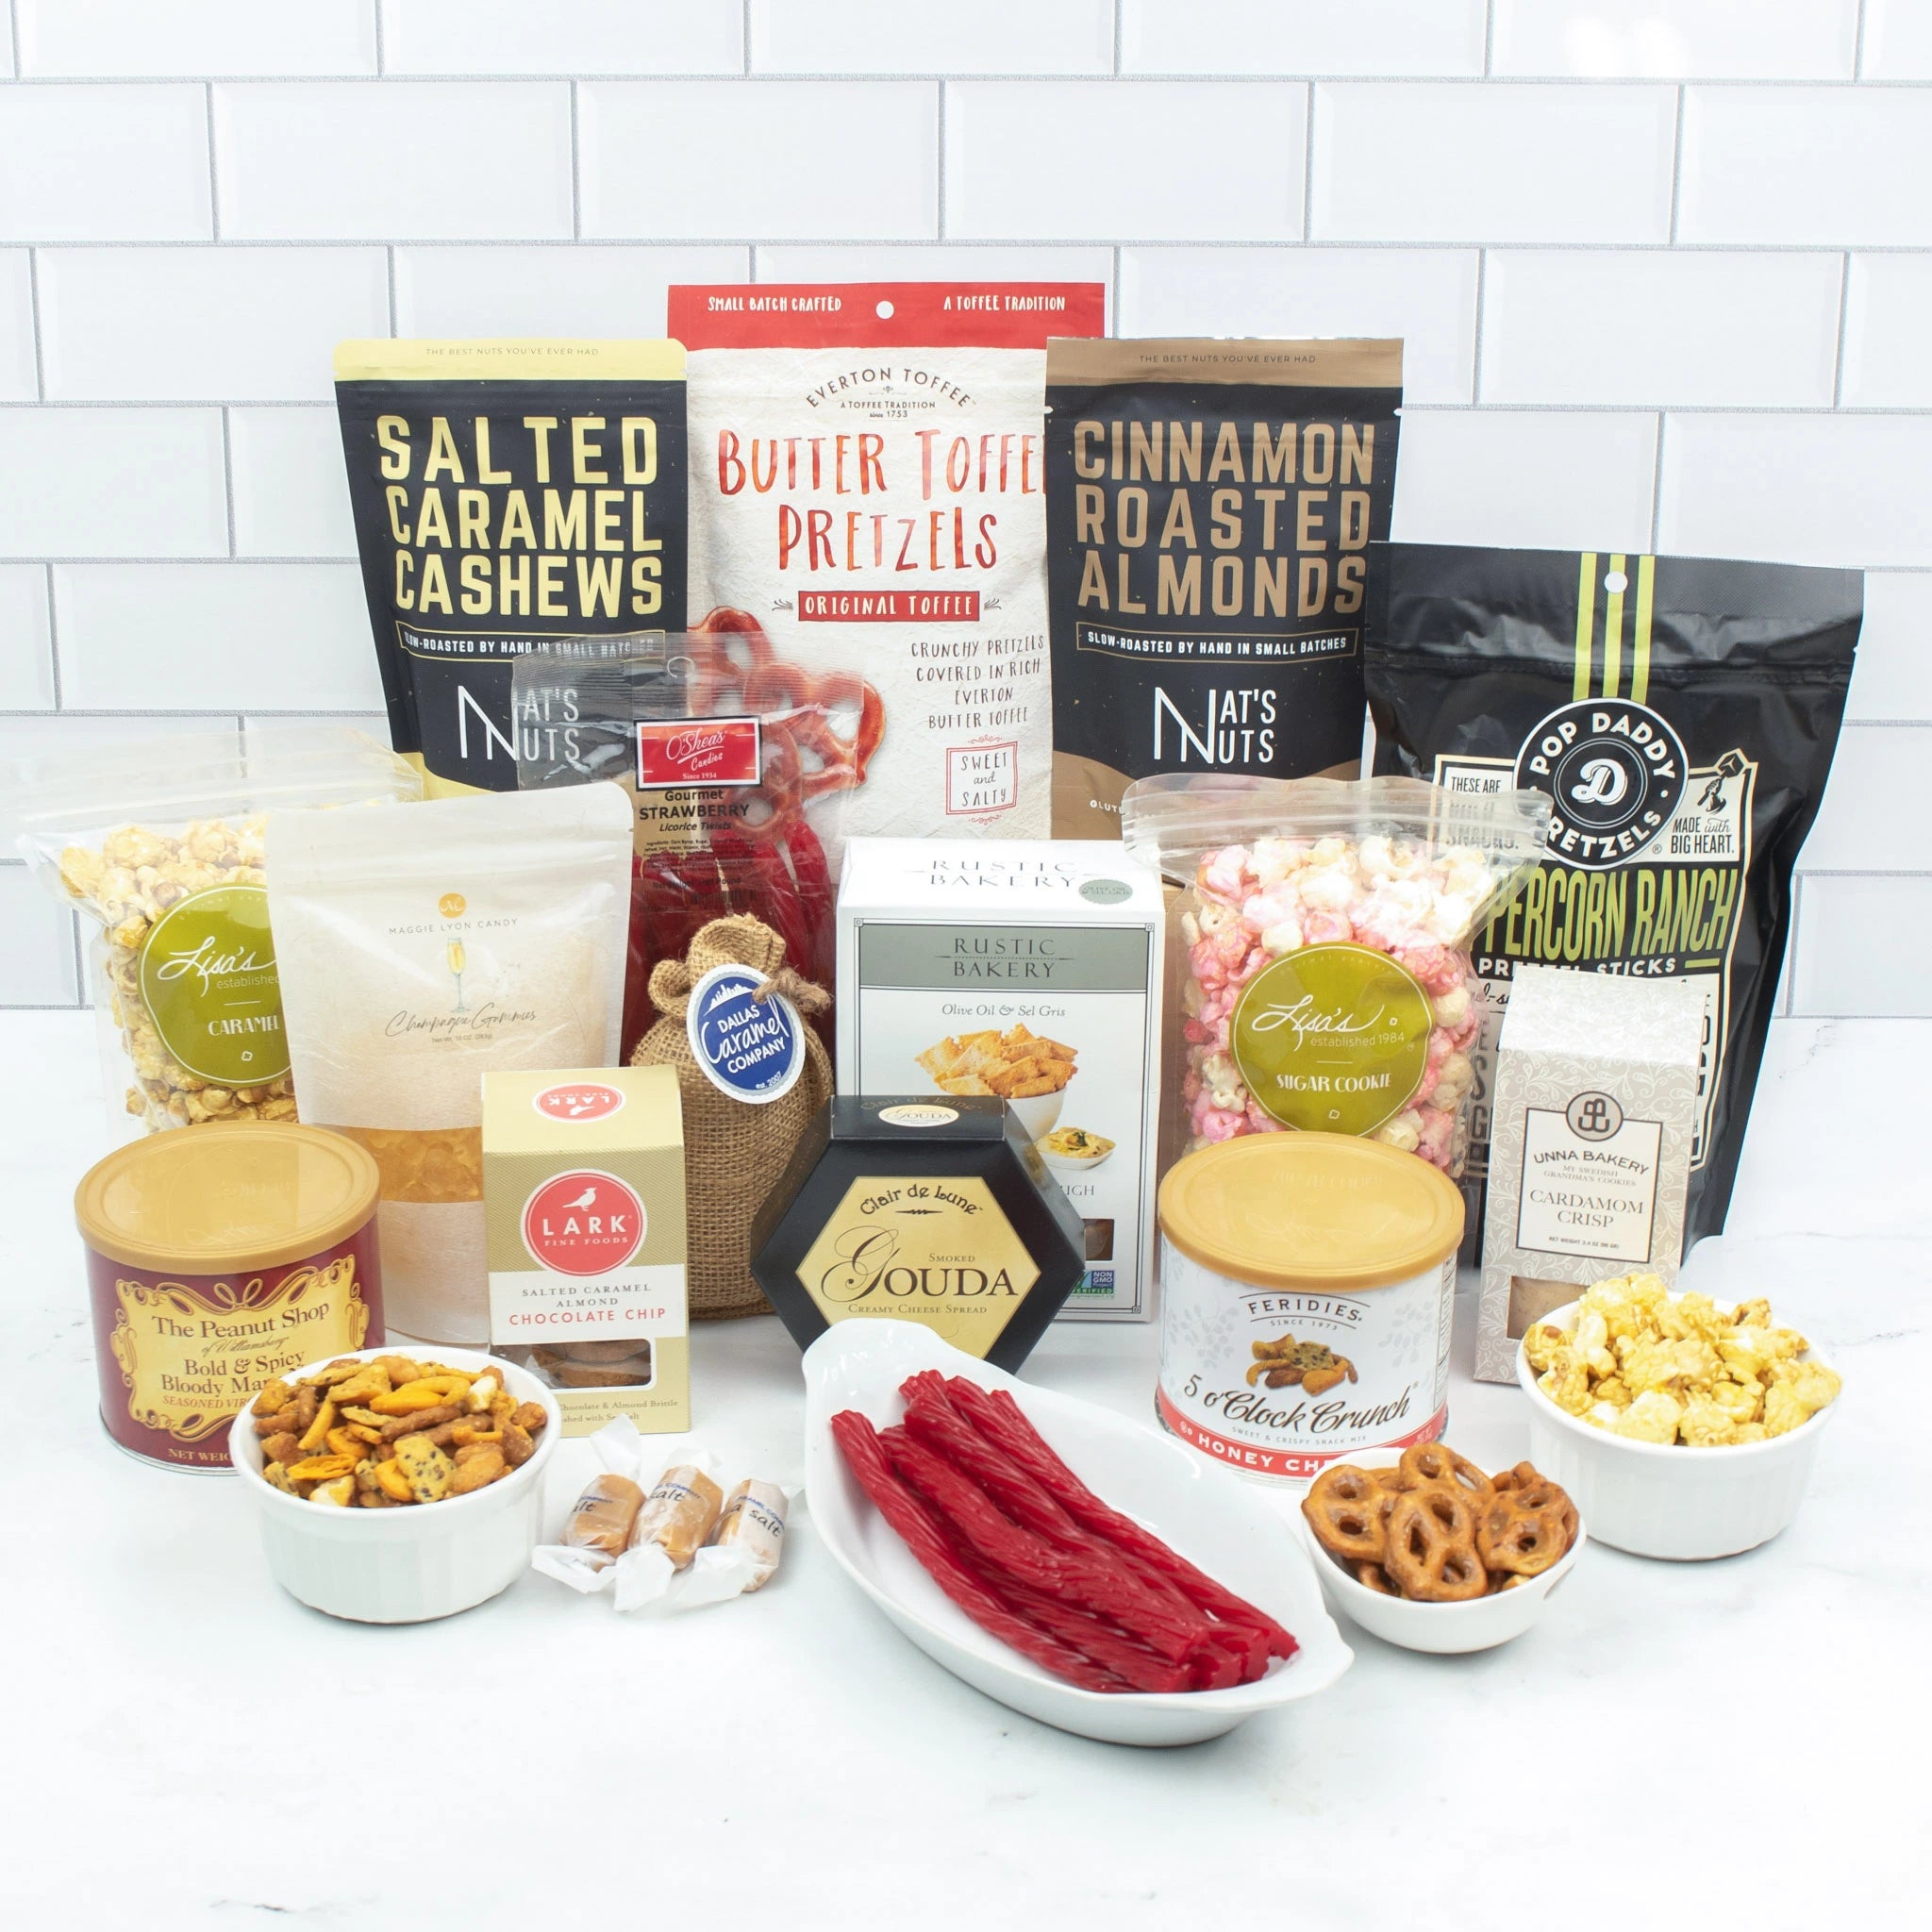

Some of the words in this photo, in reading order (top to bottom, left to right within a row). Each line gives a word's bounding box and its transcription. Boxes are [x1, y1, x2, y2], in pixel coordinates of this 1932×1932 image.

[708, 296, 744, 311] SMALL
[749, 296, 787, 311] BATCH
[791, 296, 841, 312] CRAFTED
[943, 296, 951, 311] A
[956, 295, 999, 311] TOFFEE
[1005, 296, 1065, 311] TRADITION
[1140, 355, 1158, 363] THE
[1163, 355, 1188, 363] BEST
[1192, 355, 1219, 363] NUTS
[1223, 355, 1259, 363] YOU'VE
[1264, 355, 1291, 363] EVER
[1294, 355, 1316, 363] HAD
[806, 367, 891, 408] EVERTON
[903, 368, 971, 408] TOFFEE
[885, 400, 936, 408] TRADITION
[376, 415, 658, 485] SALTED
[1074, 421, 1374, 485] CINNAMON
[718, 429, 887, 496] BUTTER
[914, 429, 1047, 500] TOFFE
[385, 485, 662, 552] CARAMEL
[1075, 484, 1371, 551] ROASTED
[778, 504, 997, 572] PRETZELS
[395, 549, 662, 618] CASHEWS
[1077, 550, 1366, 618] ALMONDS
[805, 594, 897, 615] ORIGINAL
[908, 595, 973, 615] TOFFEE
[479, 641, 495, 653] BY
[500, 641, 532, 654] HAND
[538, 642, 550, 654] IN
[911, 641, 979, 658] CRUNCHY
[988, 635, 1043, 656] PRETZELS
[1088, 631, 1173, 654] SLOW-ROASTED
[1178, 641, 1194, 654] BY
[1199, 641, 1232, 655] HAND
[1238, 642, 1250, 655] IN
[1256, 642, 1295, 656] SMALL
[1300, 638, 1346, 654] BATCHES
[916, 665, 981, 682] COVERED
[990, 664, 1004, 679] IN
[1009, 658, 1041, 677] RICH
[955, 687, 1013, 705] EVERTON
[928, 712, 981, 729] BUTTER
[990, 707, 1028, 725] TOFFEE
[485, 727, 581, 761] NUTS
[666, 727, 725, 760] O'Shea's
[1180, 724, 1274, 764] NUTS
[1529, 722, 1578, 775] POP
[1591, 712, 1675, 780] DADDY
[691, 752, 724, 772] Candies
[961, 752, 1008, 771] SWEET
[701, 772, 717, 780] 1934
[974, 772, 996, 785] and
[1451, 776, 1480, 793] THESE
[665, 790, 724, 802] Gourmet
[962, 789, 1007, 807] SALTY
[640, 804, 750, 820] STRAWBERRY
[659, 822, 697, 832] Licorice
[700, 821, 733, 832] Twists
[1673, 816, 1701, 833] MADE
[1704, 817, 1732, 834] with
[1671, 835, 1691, 854] BIG
[1693, 835, 1735, 854] HEART.
[931, 860, 1077, 873] RUSTIC
[930, 874, 1077, 888] BAKERY
[1485, 867, 1628, 962] PERCORN
[1630, 867, 1739, 958] RANCH
[389, 924, 435, 935] MAGGIE
[441, 922, 472, 932] LYON
[477, 918, 518, 928] CANDY
[955, 938, 1056, 955] RUSTIC
[158, 936, 278, 997] Lisa's
[954, 962, 1056, 978] BAKERY
[1596, 958, 1676, 976] STICKS
[717, 1005, 760, 1034] DALLAS
[941, 1004, 974, 1016] Olive
[975, 1005, 995, 1016] Oil
[998, 1005, 1015, 1016] &
[1018, 1005, 1035, 1016] Sel
[1039, 1005, 1066, 1017] Gris
[385, 1010, 471, 1037] Champagne
[701, 994, 790, 1064] Caramel
[1251, 994, 1384, 1052] Lisa's
[1310, 1035, 1375, 1048] established
[1378, 1032, 1405, 1044] 1984
[727, 1037, 786, 1074] COMPANY
[1276, 1074, 1330, 1092] SUGAR
[1334, 1073, 1391, 1092] COOKIE
[886, 1108, 952, 1121] GOUDA
[1533, 1149, 1579, 1164] UNNA
[1583, 1150, 1649, 1174] BAKERY
[1578, 1167, 1618, 1176] SWEDISH
[1597, 1176, 1637, 1187] COOKIES
[859, 1189, 902, 1215] Clair
[908, 1184, 929, 1199] de
[934, 1185, 976, 1215] Lune
[1529, 1189, 1644, 1214] CARDAMOM
[542, 1215, 627, 1236] LARK
[1557, 1209, 1615, 1227] CRISP
[584, 1237, 628, 1246] FOODS
[821, 1225, 1019, 1303] GOUDA
[928, 1253, 975, 1263] SMOKED
[522, 1287, 577, 1297] SALTED
[584, 1283, 652, 1294] CARAMEL
[557, 1297, 619, 1307] ALMOND
[848, 1304, 893, 1314] CREAMY
[898, 1304, 941, 1314] CHEESE
[946, 1304, 988, 1314] SPREAD
[1247, 1298, 1359, 1322] FERIDIES
[152, 1314, 194, 1338] The
[200, 1318, 276, 1339] Peanut
[281, 1302, 330, 1330] Shop
[509, 1310, 615, 1325] CHOCOLATE
[625, 1307, 666, 1321] CHIP
[1270, 1319, 1304, 1327] SINCE
[1311, 1320, 1339, 1331] 1973
[184, 1359, 227, 1376] Bold
[234, 1357, 251, 1374] &
[256, 1351, 306, 1375] Spicy
[160, 1374, 224, 1398] Bloody
[162, 1395, 224, 1409] SEASONED
[1183, 1374, 1203, 1398] 5
[1204, 1390, 1307, 1433] o'Clock
[1310, 1385, 1411, 1434] Crunch
[1232, 1426, 1259, 1439] SWEET
[1276, 1437, 1310, 1445] CRISPY
[168, 1448, 194, 1460] NET
[1198, 1433, 1274, 1468] HONEY
[749, 1509, 781, 1538] salt
